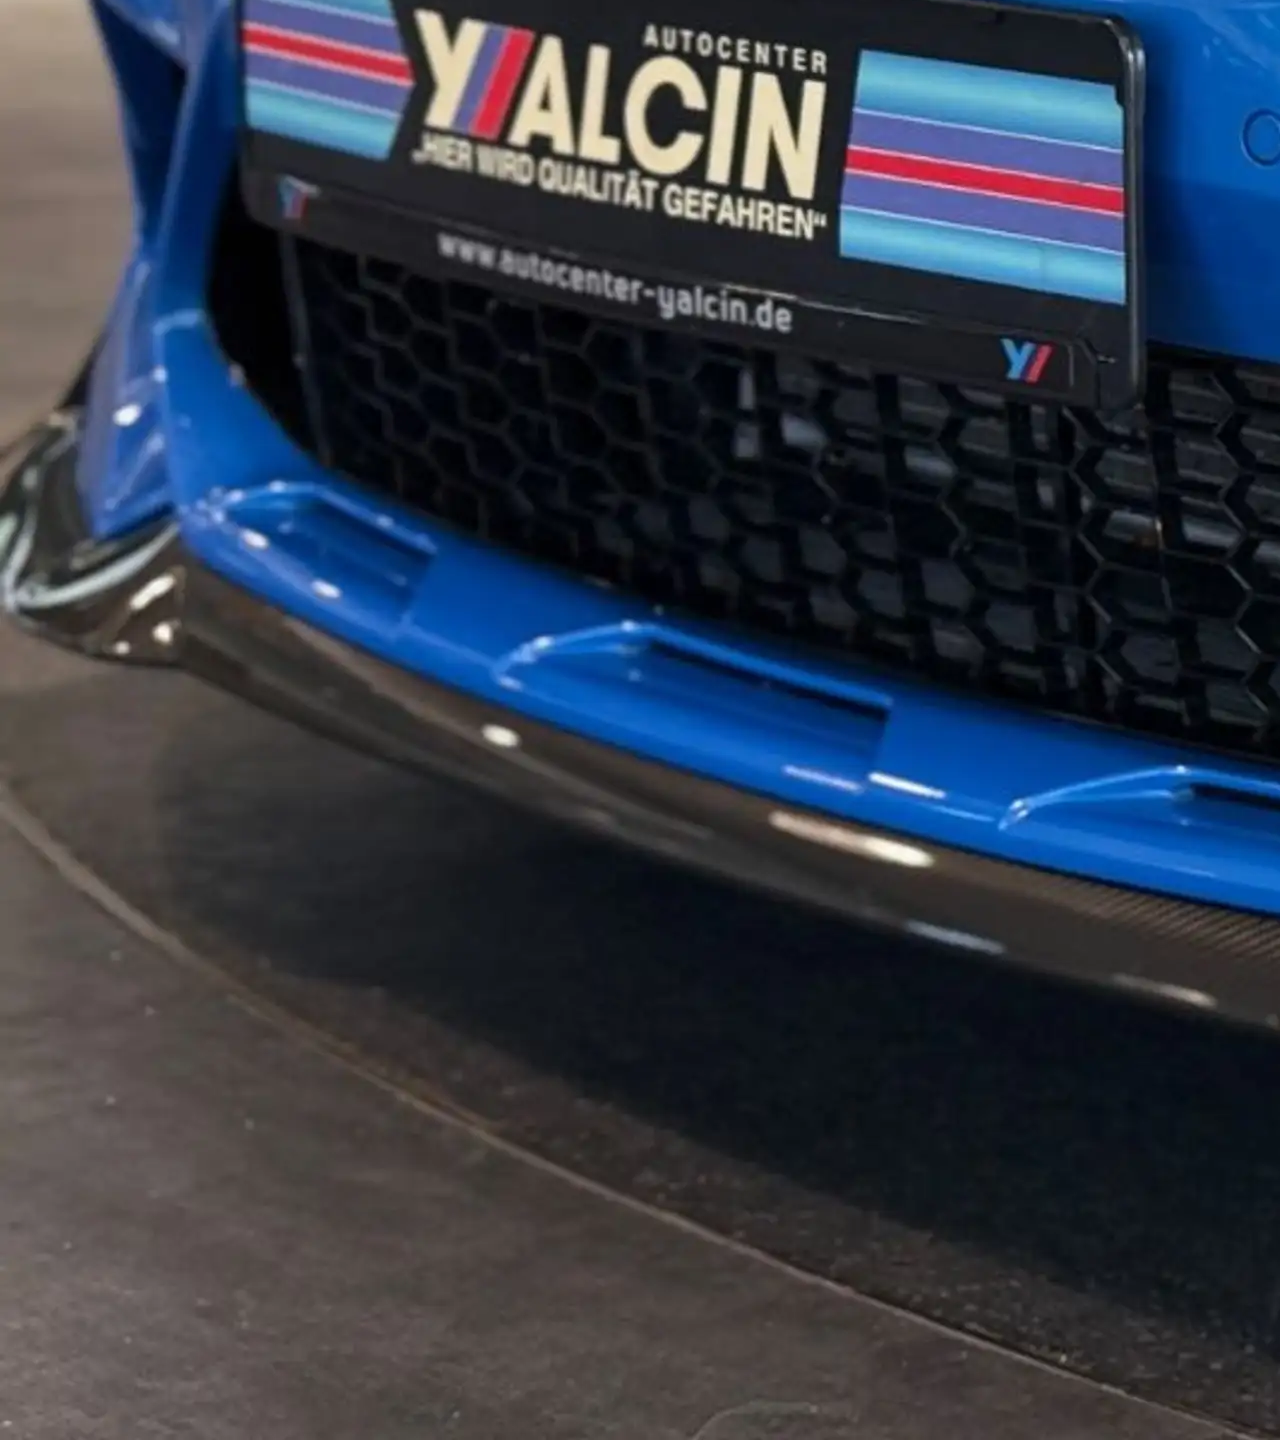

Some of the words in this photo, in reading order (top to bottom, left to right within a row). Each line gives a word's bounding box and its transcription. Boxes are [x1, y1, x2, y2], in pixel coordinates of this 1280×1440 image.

[643, 23, 827, 74] AUTOCENTER
[477, 143, 535, 186] WIRD
[538, 157, 659, 210] QUALITÄT
[437, 232, 793, 334] www.autocenter-yalcin.de
